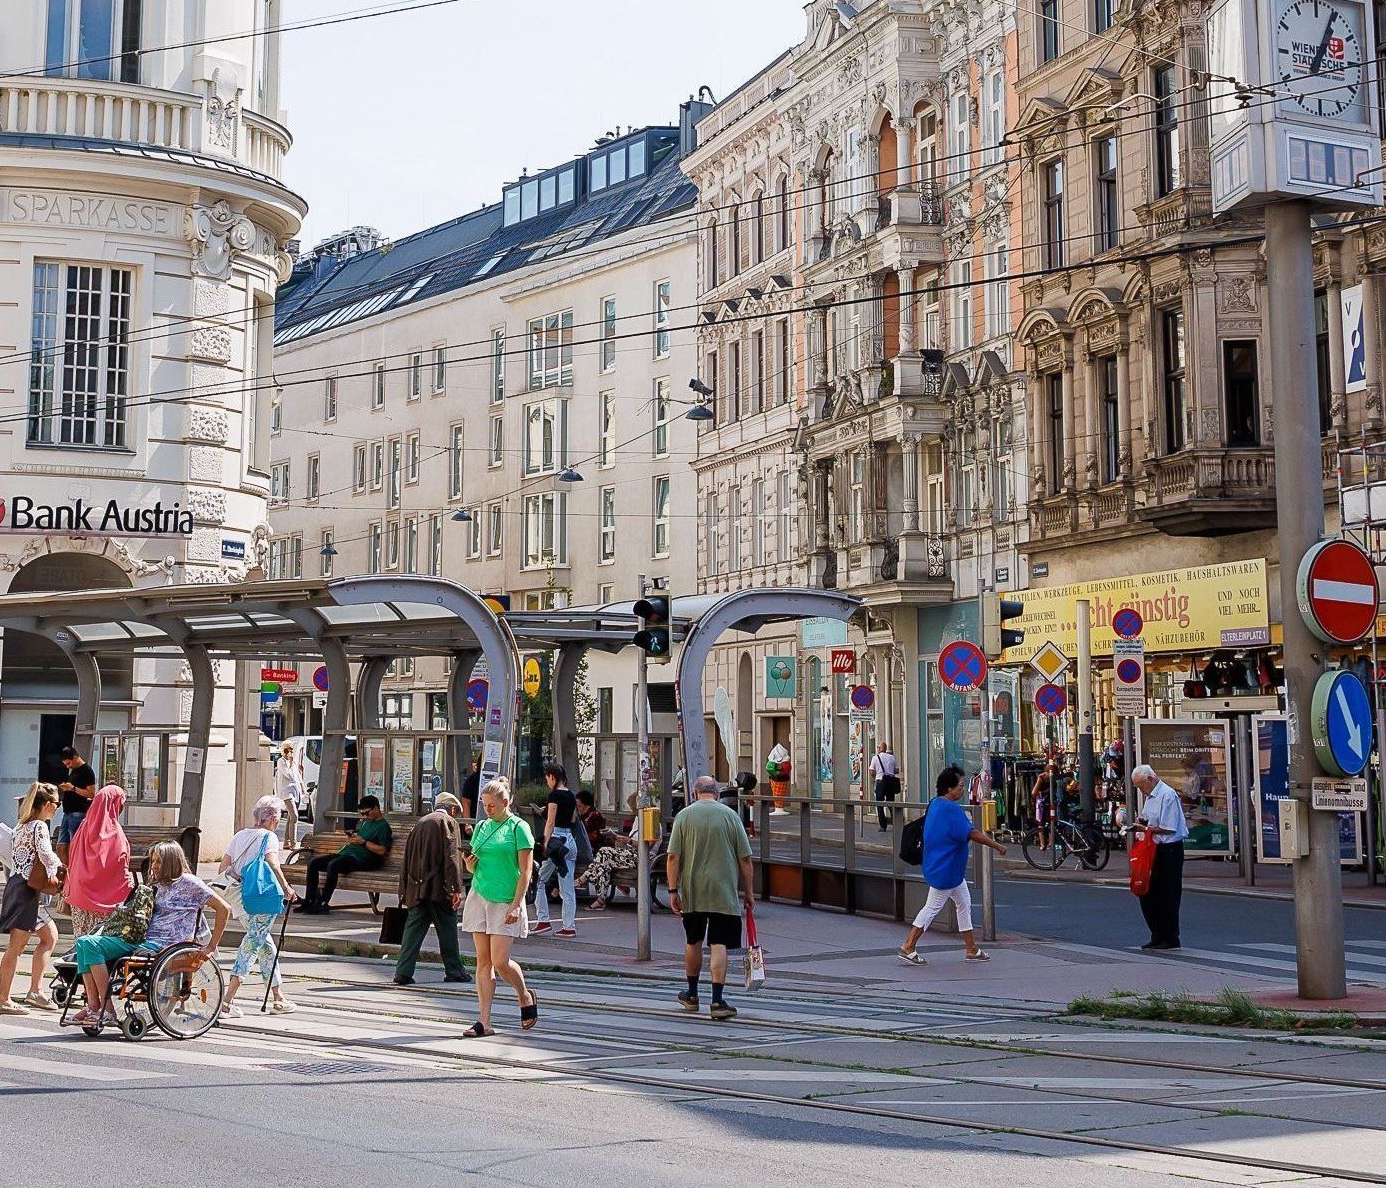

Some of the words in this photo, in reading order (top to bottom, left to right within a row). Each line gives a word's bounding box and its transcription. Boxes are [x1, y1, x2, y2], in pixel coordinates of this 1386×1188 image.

[1292, 41, 1327, 57] WIEN
[1292, 53, 1345, 70] STÄDSCHE
[12, 194, 169, 234] SPARKASSE
[11, 496, 93, 531] Bank
[100, 499, 194, 534] Austria
[1187, 562, 1260, 581] HAUSHALTSWAREN
[1218, 590, 1232, 602] UND
[1239, 587, 1260, 598] NOCH
[1218, 605, 1233, 616] VIEL
[1156, 629, 1206, 645] NÄHZUBEHÖR
[1221, 631, 1262, 642] ELTERLEINPLATZ
[833, 654, 852, 671] illy
[950, 683, 976, 691] ANFANG
[1354, 782, 1365, 792] und
[1316, 795, 1364, 808] Linienomnibusse
